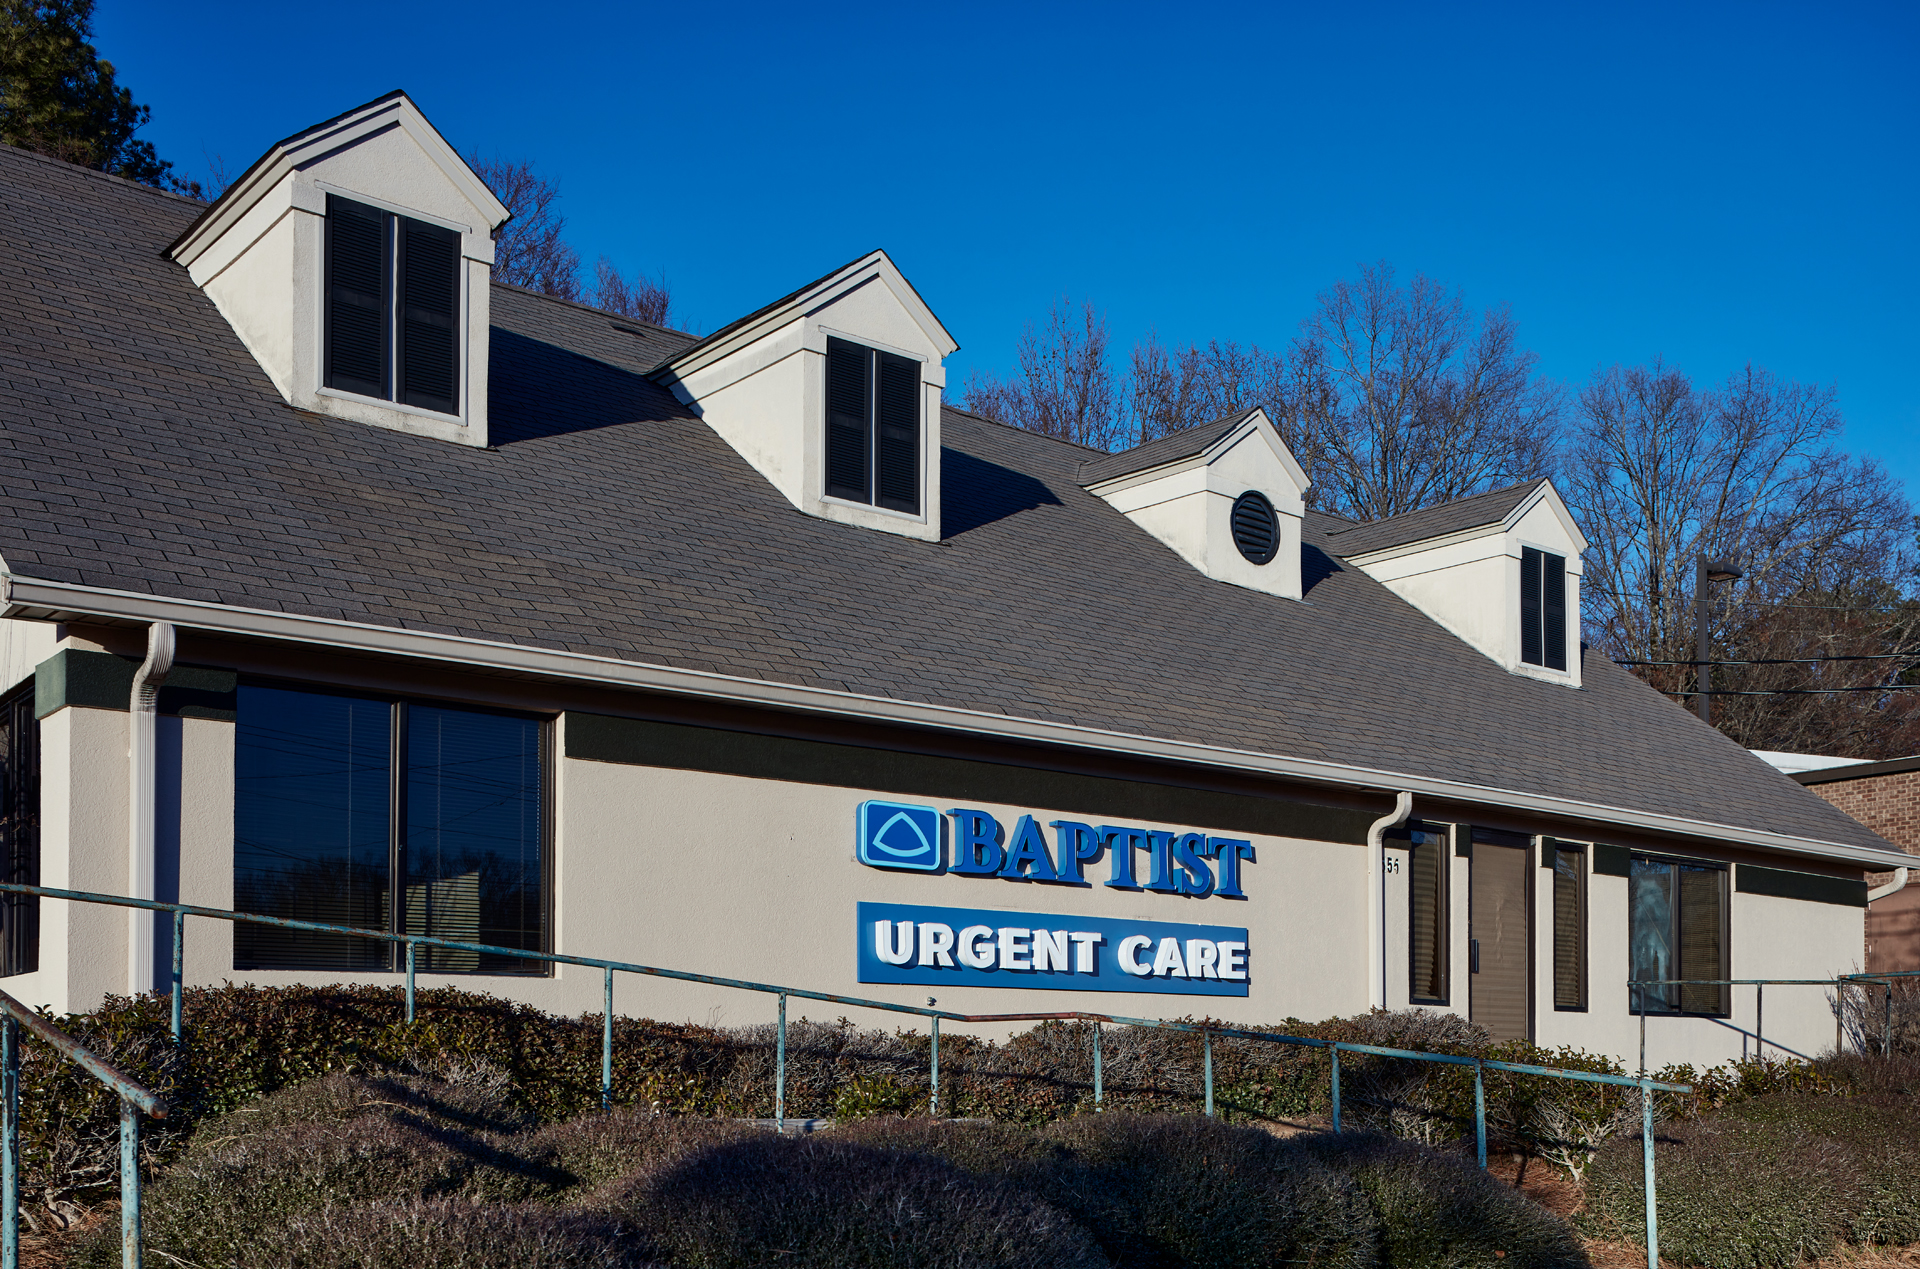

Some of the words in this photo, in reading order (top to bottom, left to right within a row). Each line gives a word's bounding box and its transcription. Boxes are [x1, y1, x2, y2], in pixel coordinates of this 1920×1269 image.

[946, 808, 1252, 897] BAPTIST
[875, 920, 1101, 973] URGENT
[1118, 935, 1246, 979] CARE
